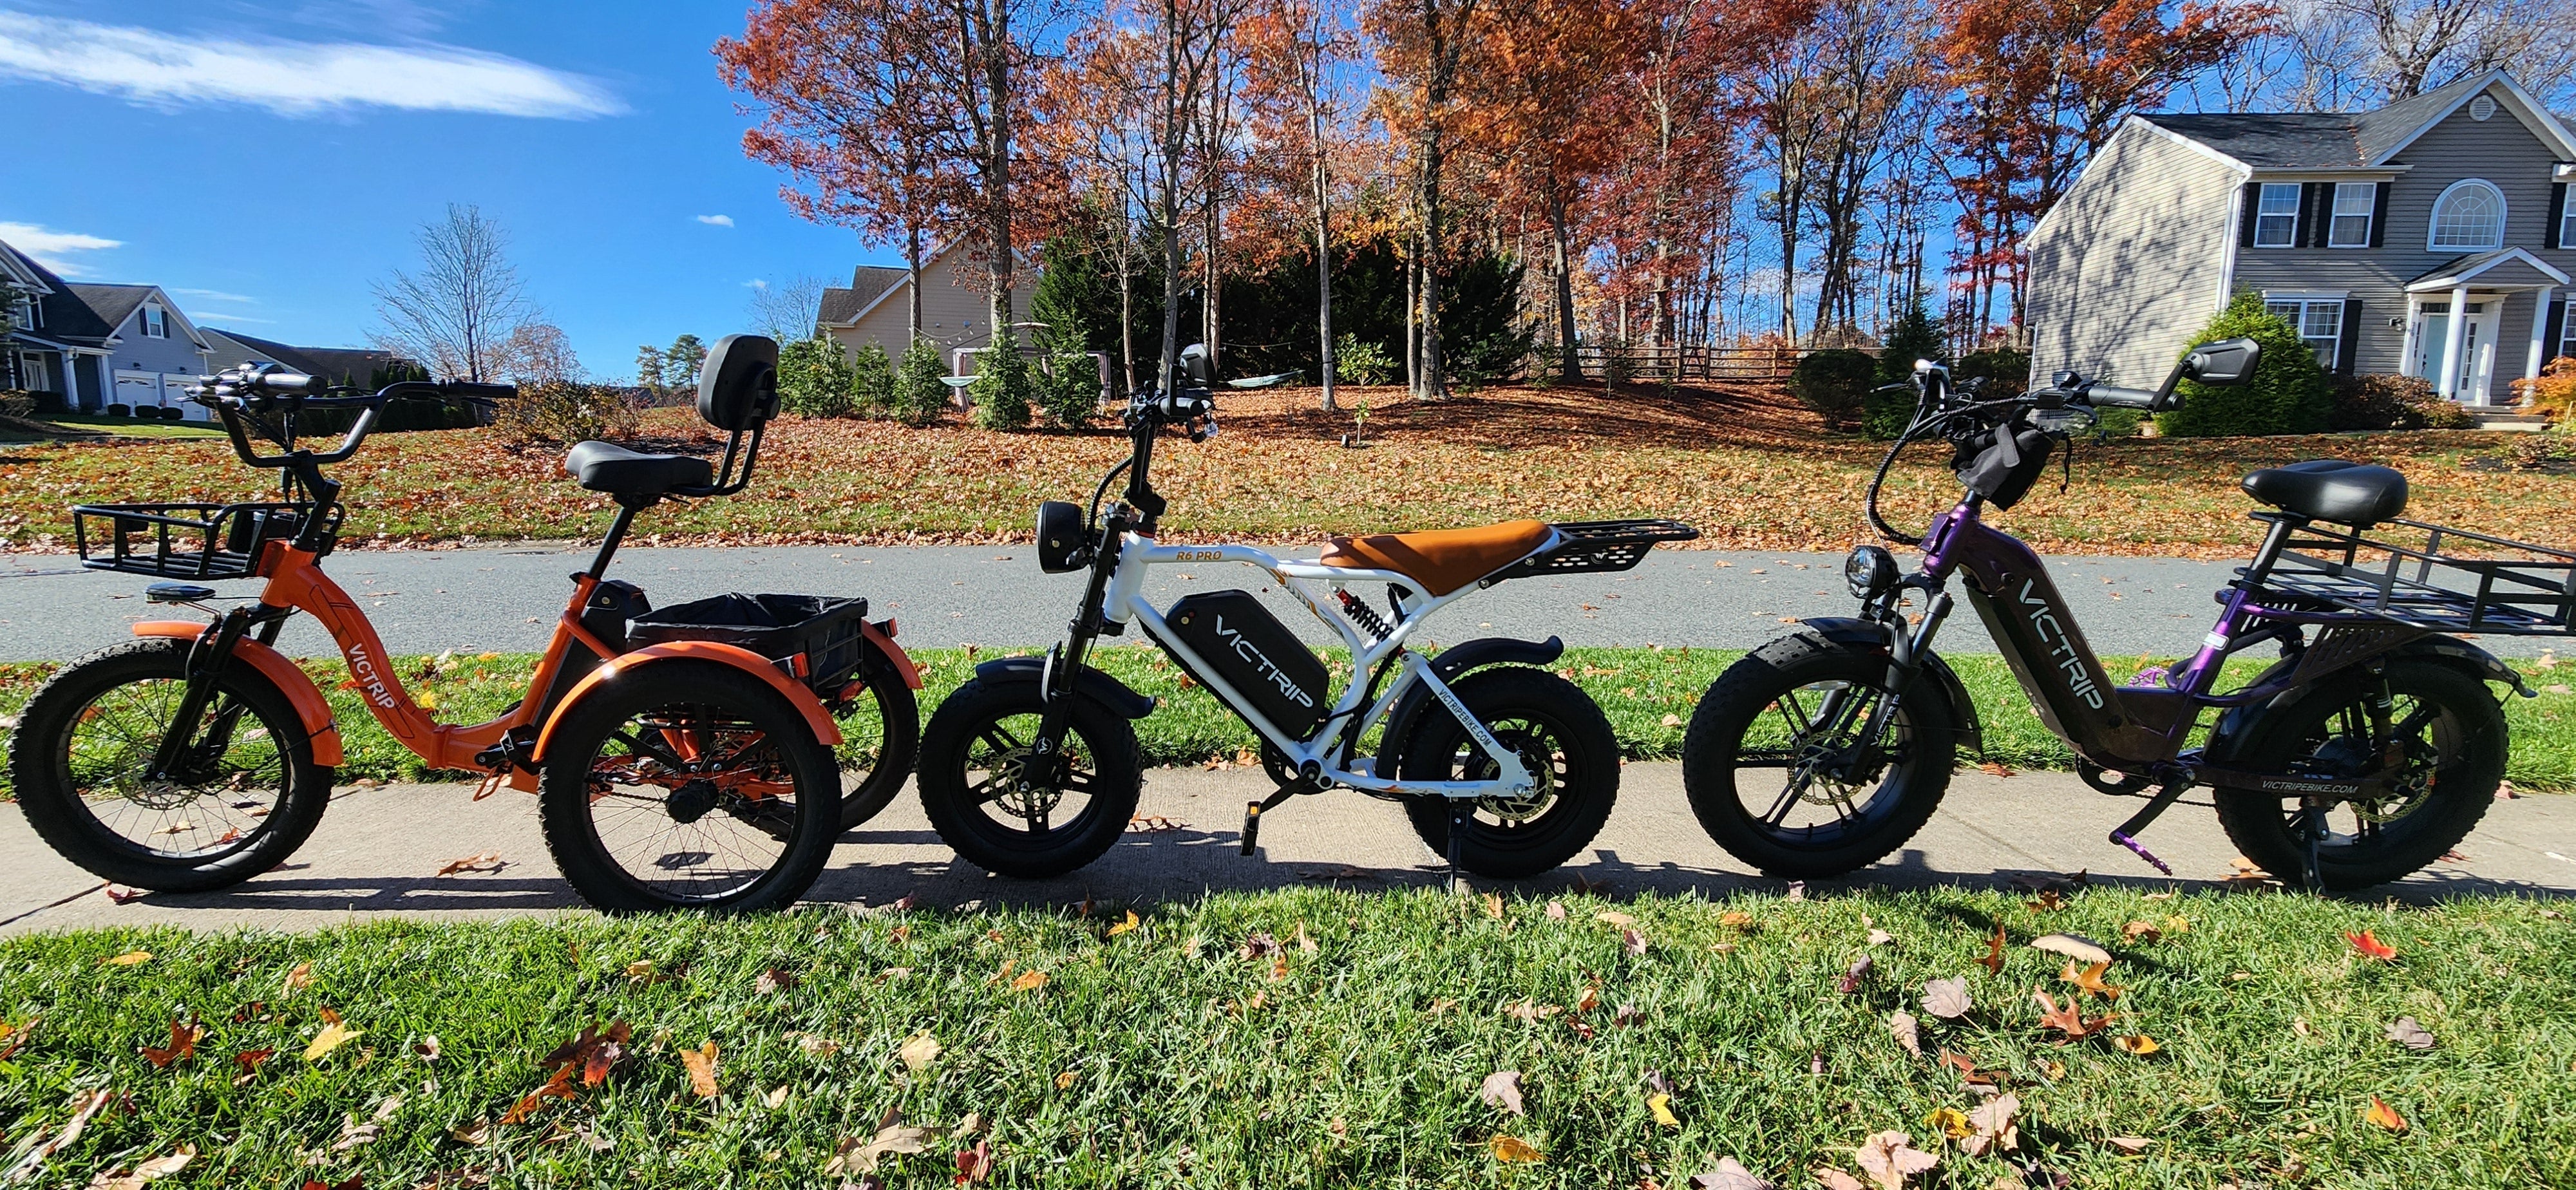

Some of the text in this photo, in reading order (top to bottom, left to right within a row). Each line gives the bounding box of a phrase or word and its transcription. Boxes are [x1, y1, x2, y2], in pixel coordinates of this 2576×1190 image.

[1176, 551, 1193, 560] R6
[1216, 614, 1314, 708] VICTRIP
[2020, 578, 2104, 710] VICTRIP
[349, 643, 395, 708] VICTRIP
[1439, 688, 1492, 747] VICTRIPEBIKE.COM
[1870, 694, 1900, 746] VICTRP
[2262, 780, 2359, 793] VICTRIPEBIKE.COM
